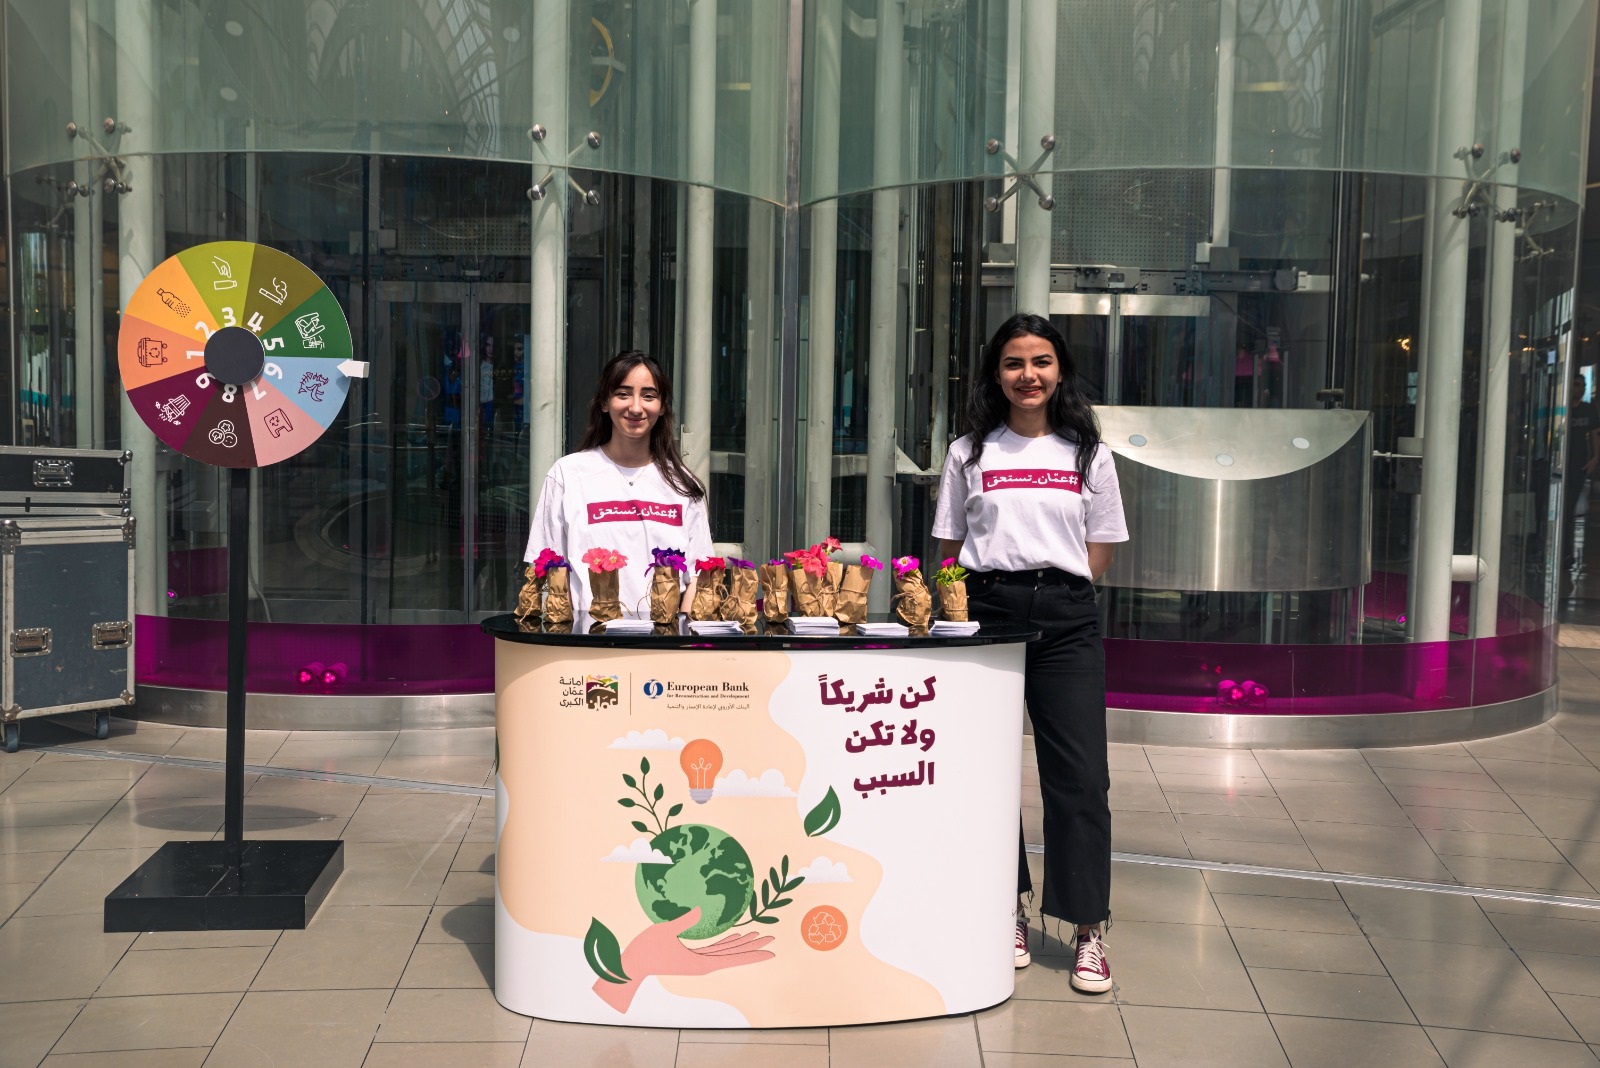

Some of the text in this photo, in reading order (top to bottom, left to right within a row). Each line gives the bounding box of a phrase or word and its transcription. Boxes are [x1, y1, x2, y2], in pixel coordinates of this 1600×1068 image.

[221, 307, 237, 327] 3
[247, 311, 264, 332] 4
[194, 321, 216, 340] 2
[263, 337, 285, 351] 5
[186, 350, 205, 359] 1
[195, 372, 216, 389] 9
[264, 362, 283, 380] 6
[222, 384, 238, 403] 8
[250, 381, 267, 400] 7
[667, 681, 750, 694] European Bank
[818, 673, 937, 713] كن شريكاً
[845, 719, 936, 753] ولا تكن
[853, 760, 935, 799] السبب
